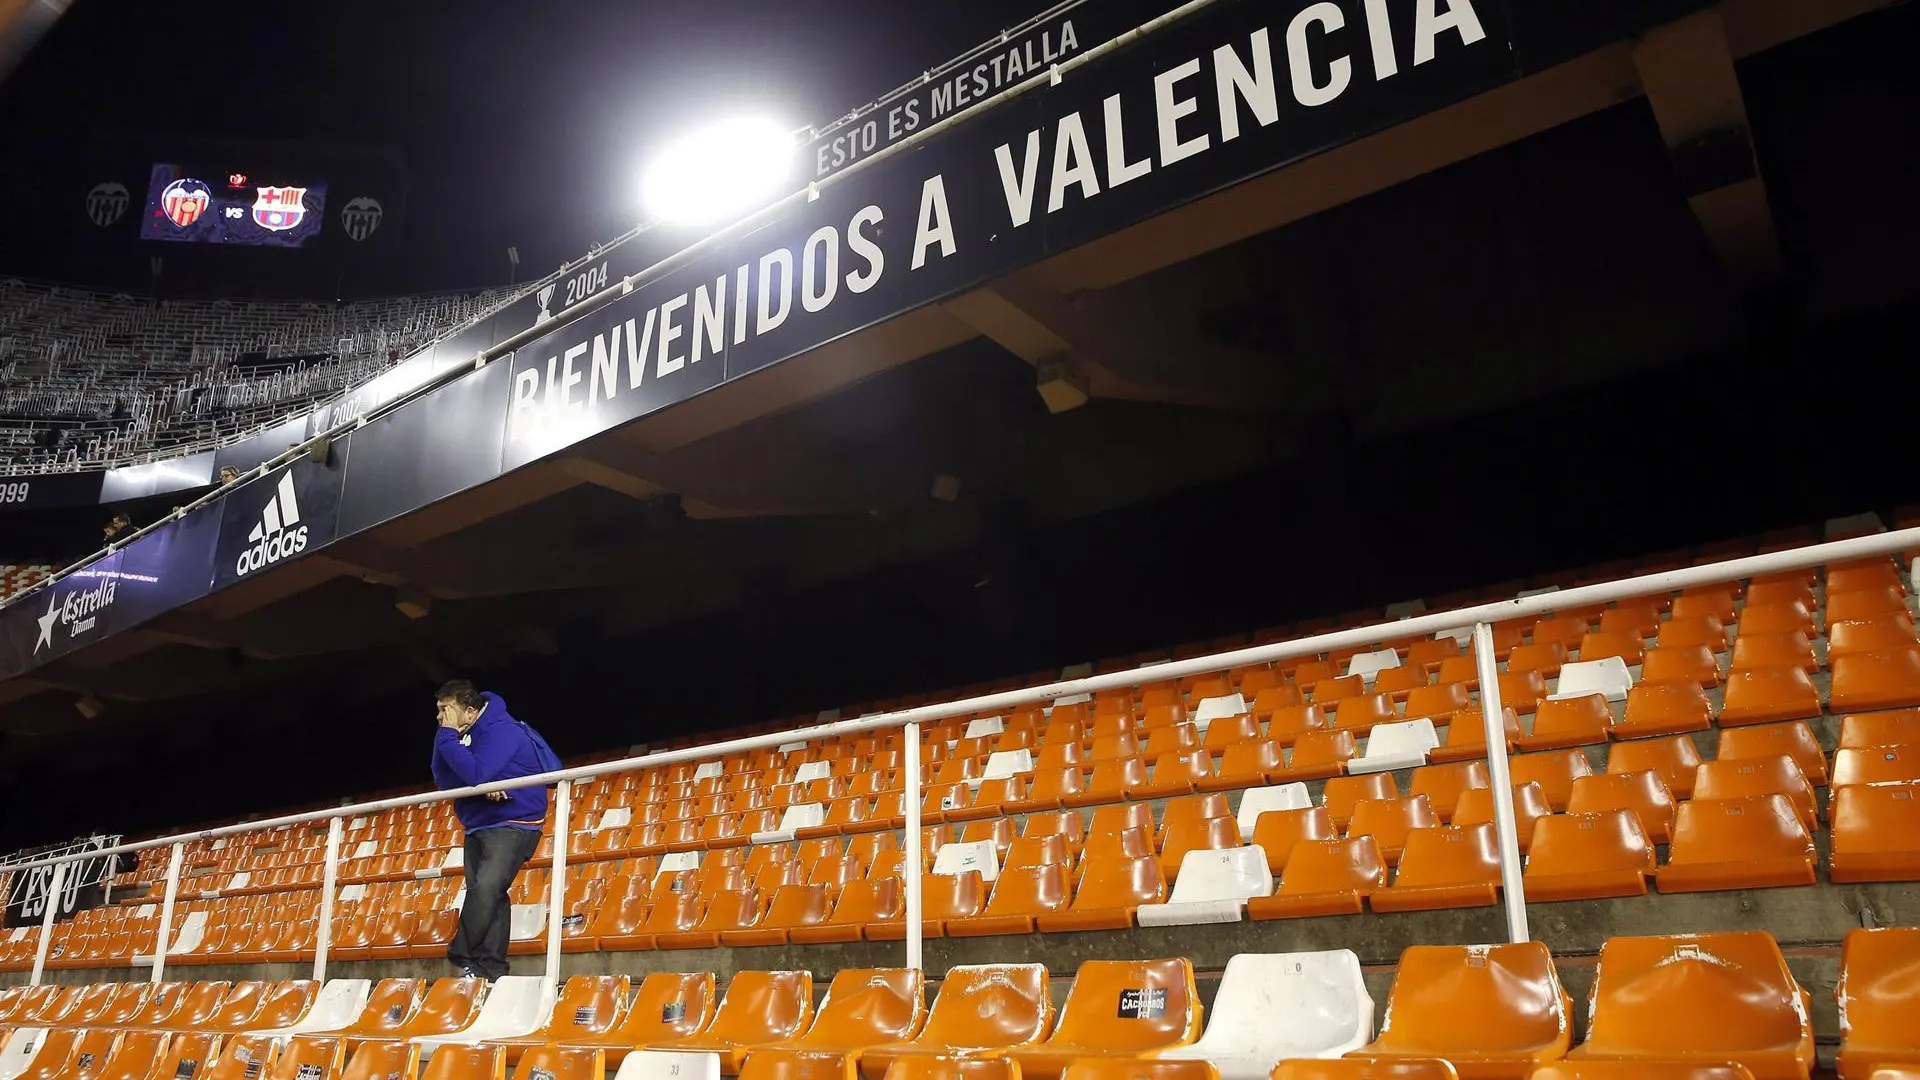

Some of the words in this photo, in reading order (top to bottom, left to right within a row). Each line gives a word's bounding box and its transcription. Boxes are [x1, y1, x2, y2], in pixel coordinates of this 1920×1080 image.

[817, 121, 876, 176] ESTO
[888, 98, 919, 140] ES
[931, 20, 1078, 119] MESTALLA
[225, 207, 244, 219] VS
[510, 204, 885, 441] BIENVENIDOS
[911, 174, 957, 270] A
[994, 0, 1486, 228] VALENCIA
[564, 261, 608, 307] 2004
[236, 525, 308, 576] adidas
[61, 577, 116, 625] Estrella
[71, 616, 96, 638] Damm
